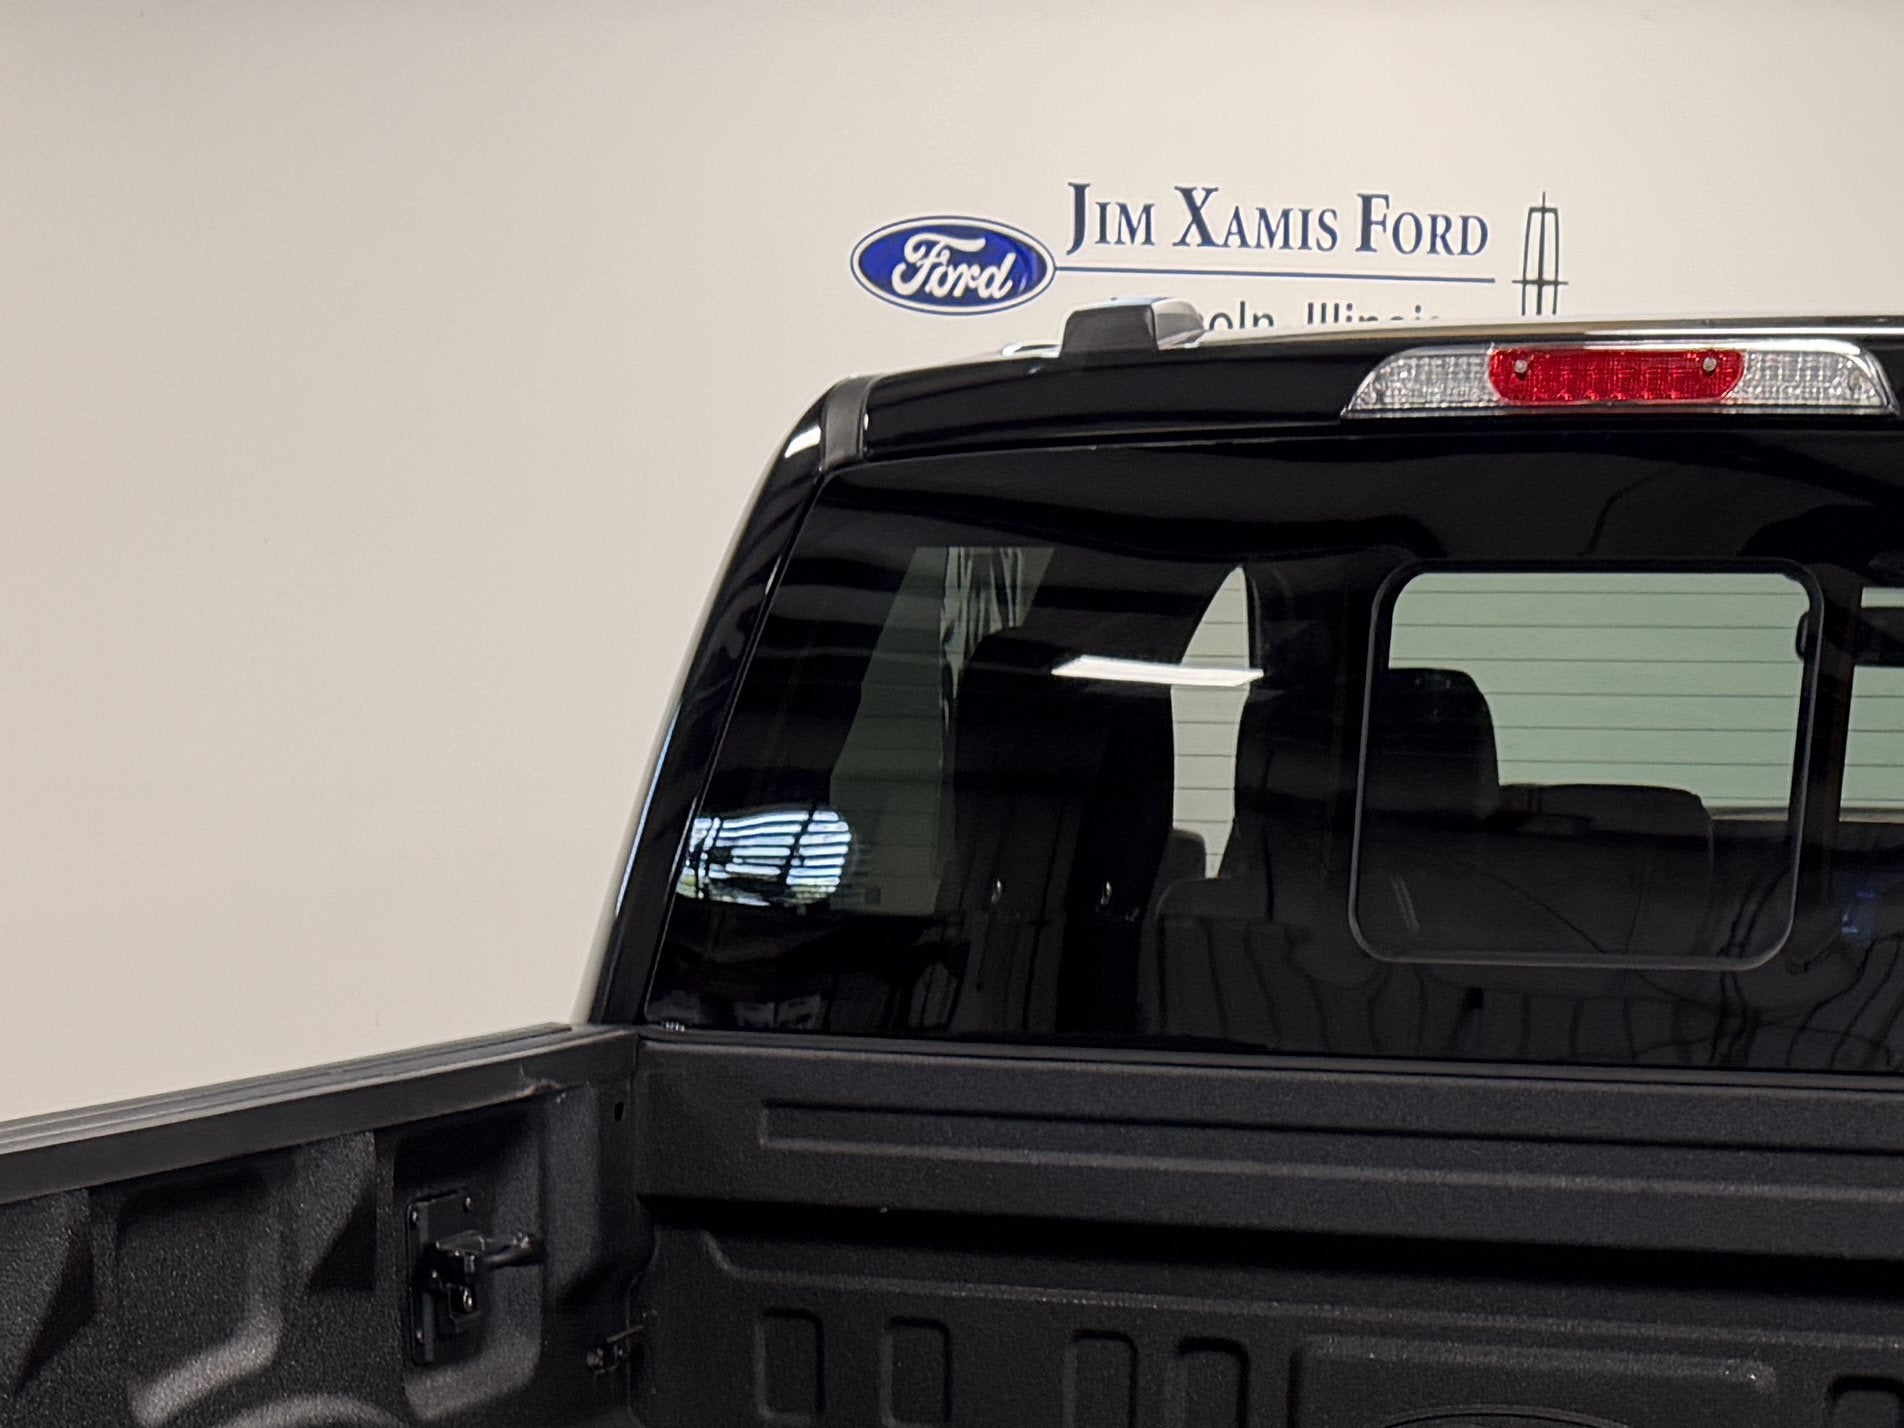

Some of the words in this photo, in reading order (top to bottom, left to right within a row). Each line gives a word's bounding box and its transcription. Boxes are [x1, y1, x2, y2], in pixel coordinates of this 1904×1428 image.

[1066, 181, 1156, 256] JIM
[1172, 184, 1338, 252] XAMIS
[1355, 192, 1490, 257] FORD
[891, 231, 1018, 299] Ford
